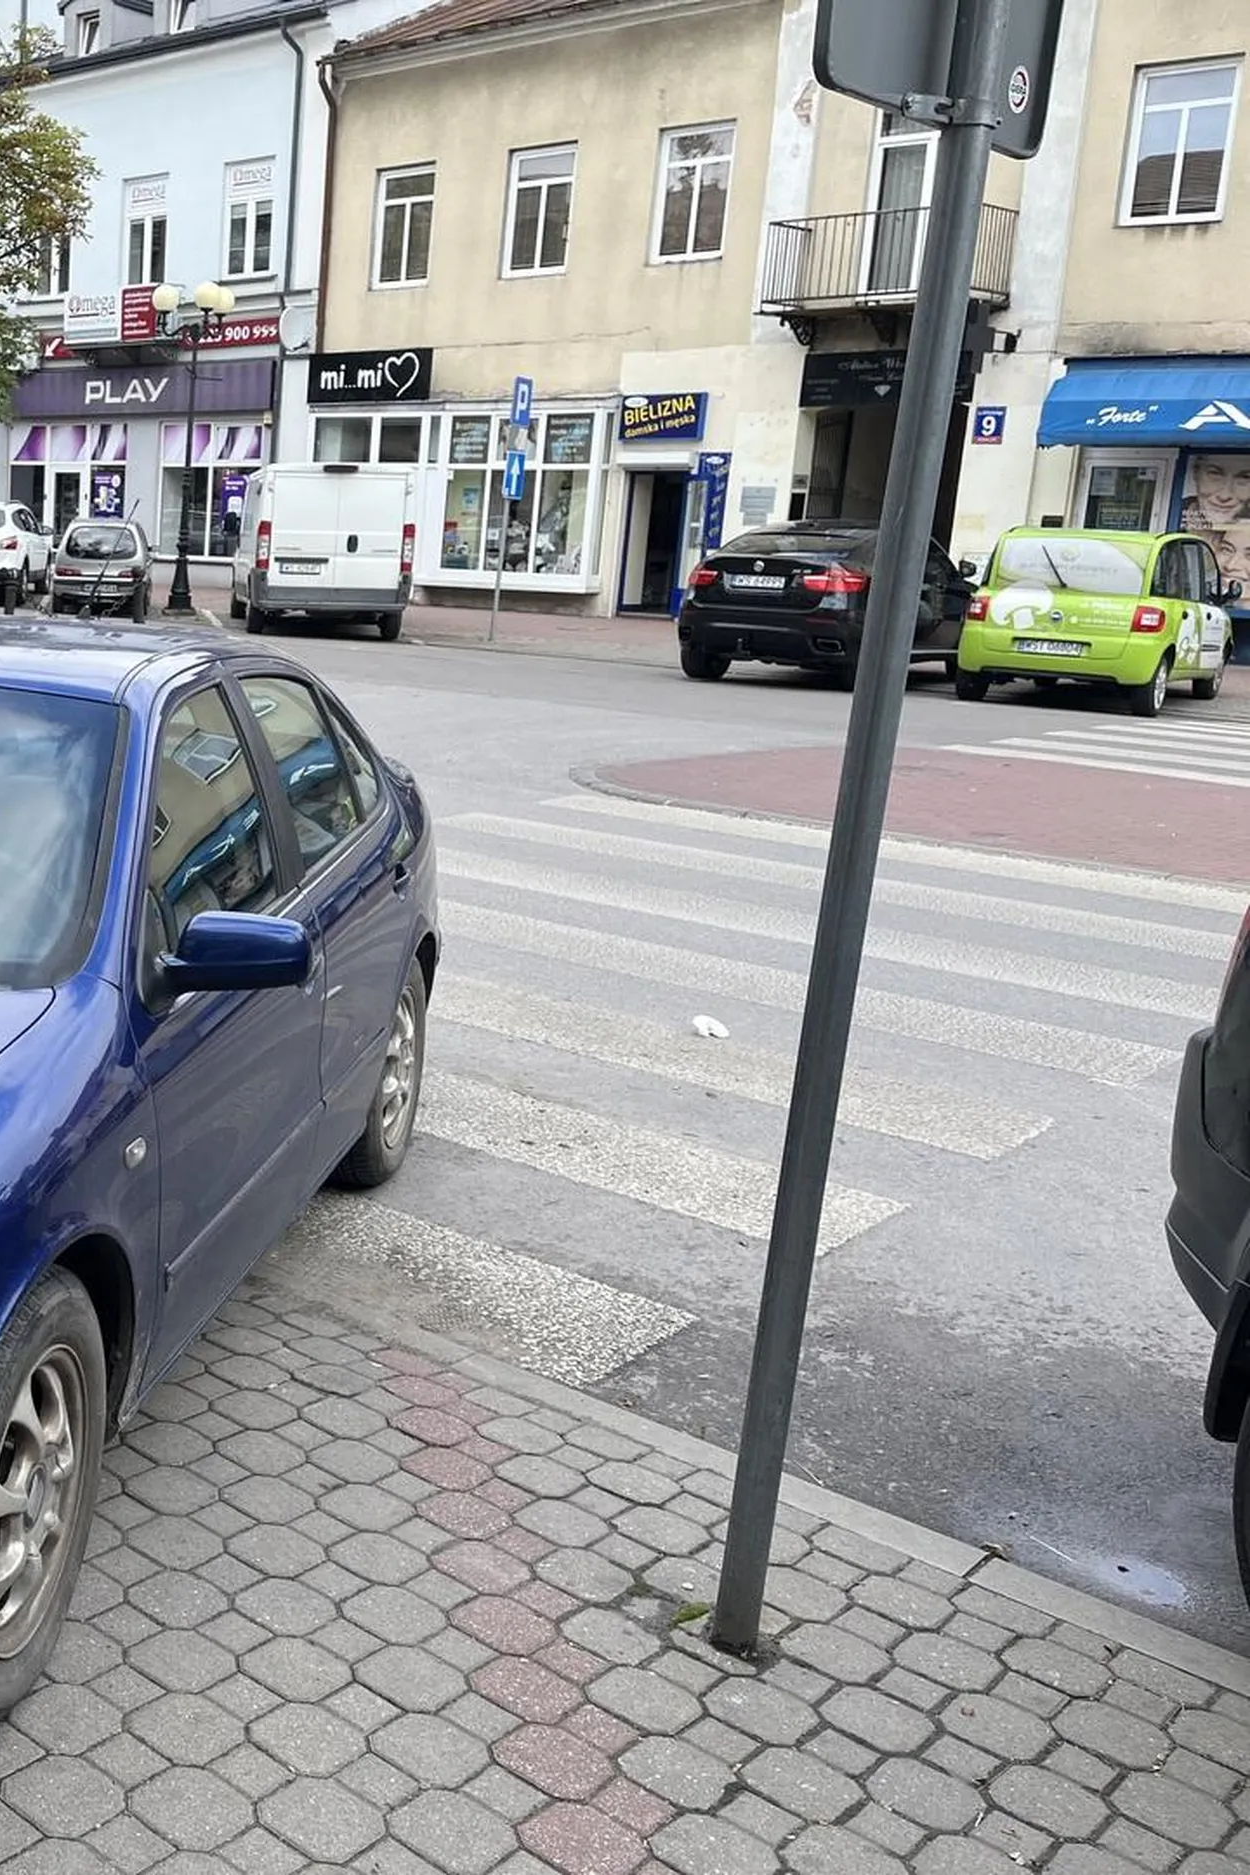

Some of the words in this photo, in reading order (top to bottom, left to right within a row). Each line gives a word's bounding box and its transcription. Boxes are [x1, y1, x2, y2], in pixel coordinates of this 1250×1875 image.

[225, 325, 250, 341] 900
[85, 377, 169, 404] PLAY
[516, 383, 529, 421] P
[624, 395, 696, 426] BIELIZNA
[624, 421, 659, 438] damska
[981, 416, 996, 436] 9
